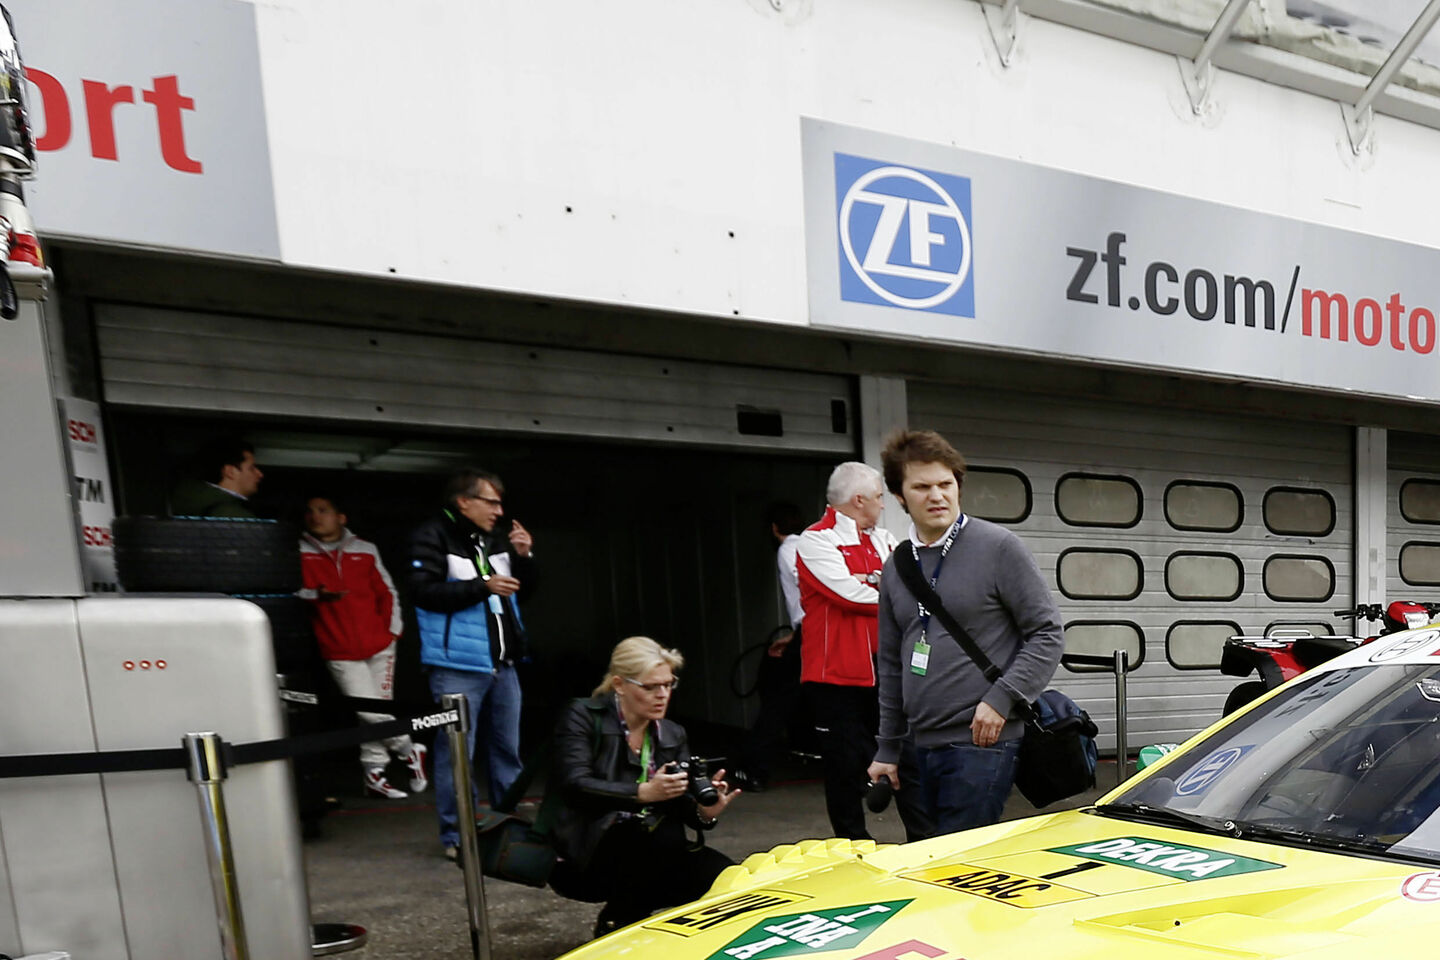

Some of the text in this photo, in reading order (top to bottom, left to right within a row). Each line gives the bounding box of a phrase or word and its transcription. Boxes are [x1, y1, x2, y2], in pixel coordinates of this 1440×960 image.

[843, 188, 964, 286] ZF
[1074, 837, 1237, 877] DEKRA
[933, 870, 1052, 900] ADAC
[763, 913, 859, 949] INA
